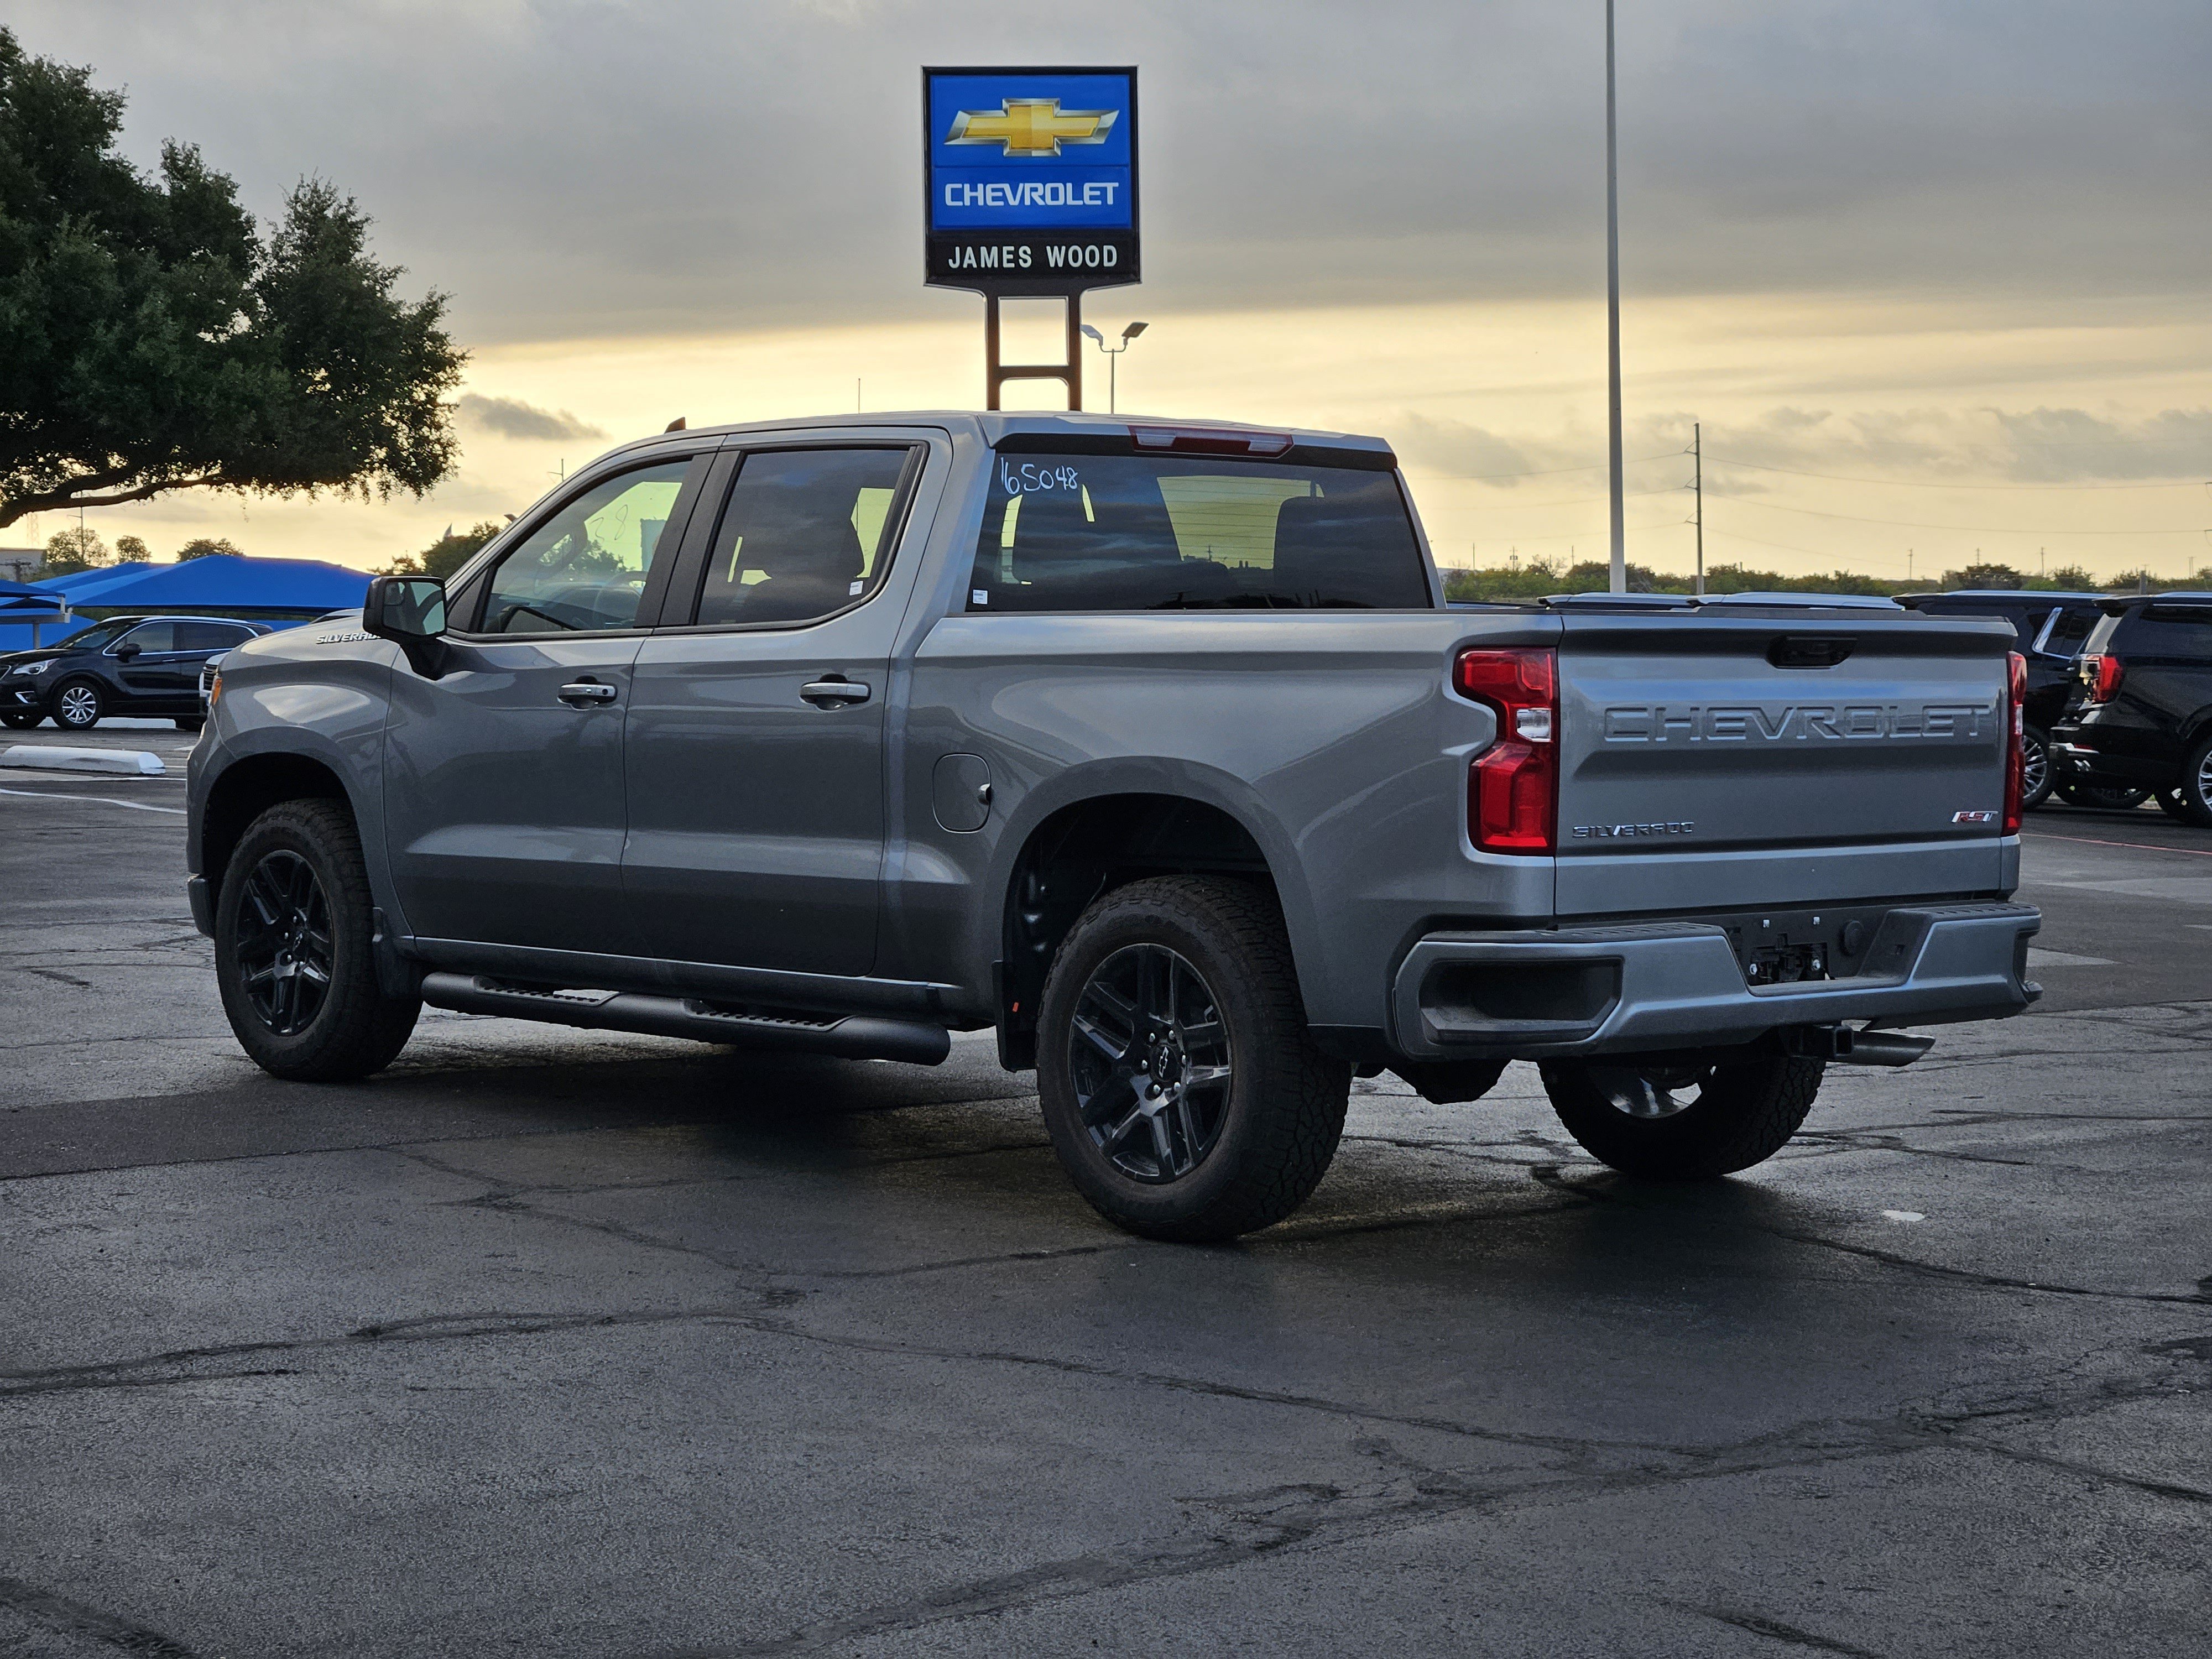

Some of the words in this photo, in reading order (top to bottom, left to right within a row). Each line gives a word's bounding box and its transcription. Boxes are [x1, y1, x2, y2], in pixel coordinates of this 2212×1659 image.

[945, 182, 1119, 206] CHEVROLET
[948, 246, 1032, 268] JAMES
[1046, 245, 1118, 267] WOOD
[1000, 456, 1078, 494] 165048
[1604, 705, 1991, 742] CHEVROLET
[1951, 810, 1999, 823] RST
[1572, 822, 1695, 838] SILVERADO
